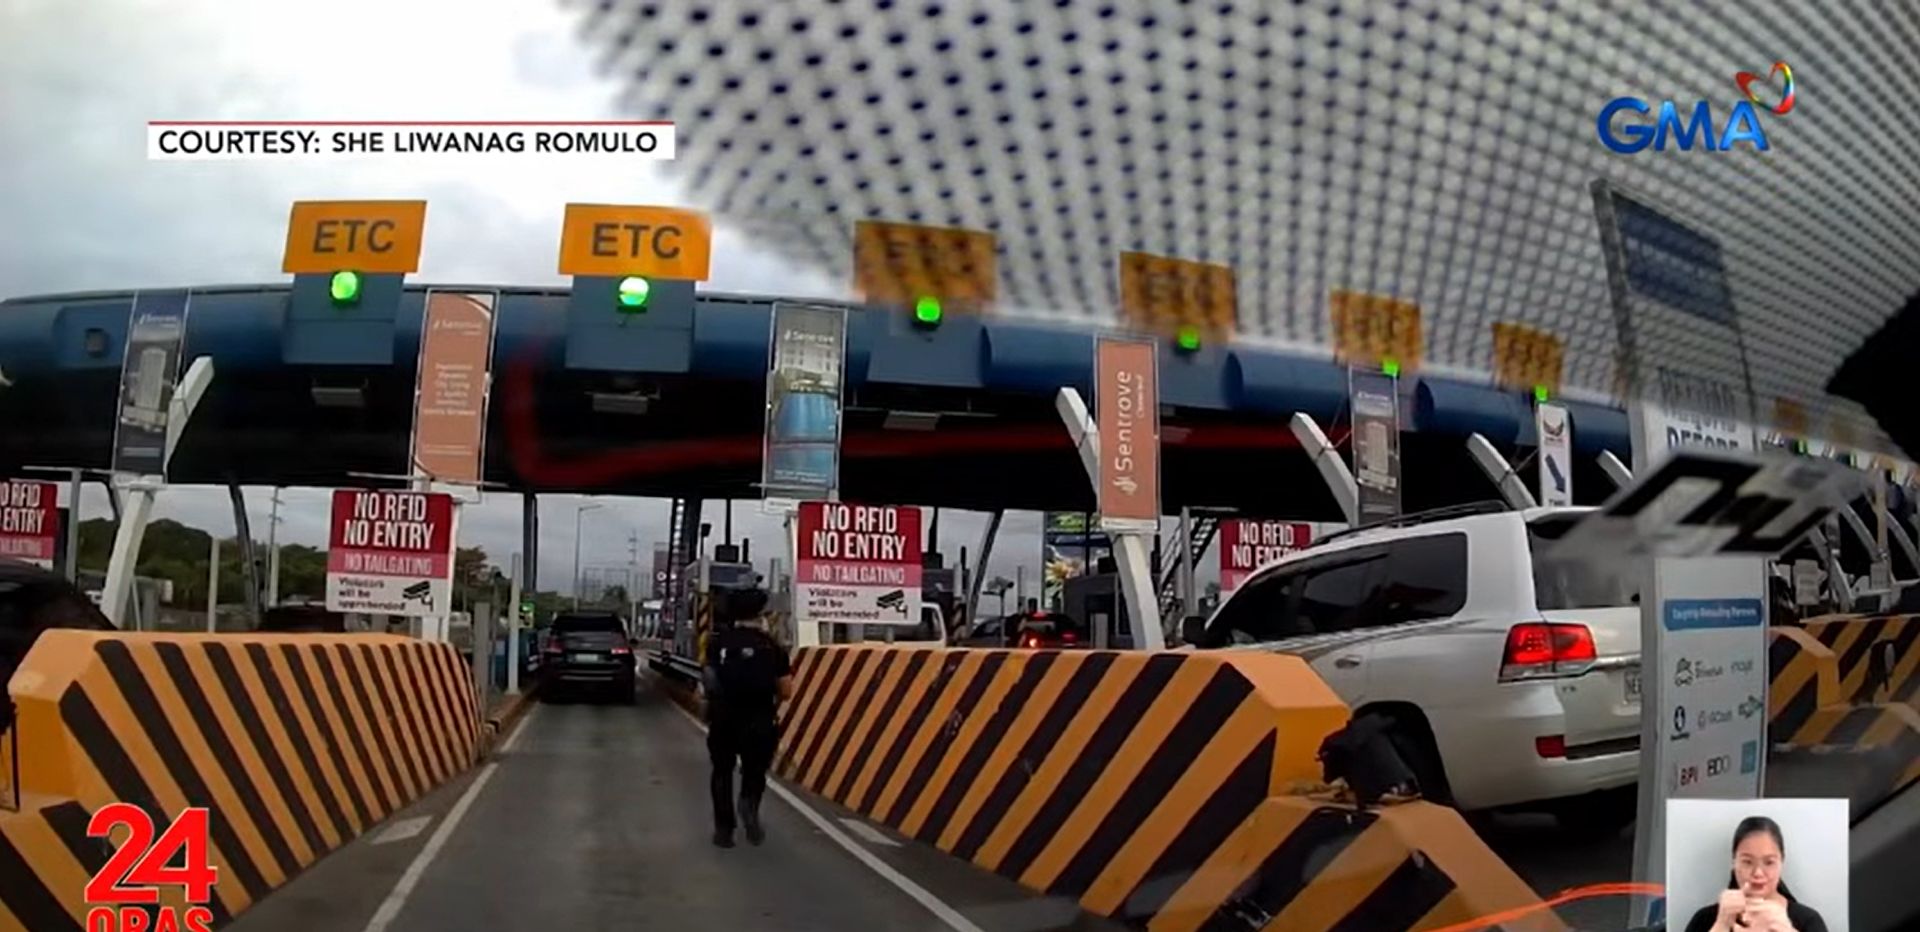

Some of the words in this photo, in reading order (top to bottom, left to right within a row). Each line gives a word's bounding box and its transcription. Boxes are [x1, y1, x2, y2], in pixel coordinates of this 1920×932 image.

[312, 219, 395, 254] ETC
[591, 221, 683, 260] ETC
[3, 507, 46, 534] ENTRY
[355, 492, 380, 520] NO
[384, 494, 427, 522] RFID
[822, 503, 850, 531] NO
[855, 506, 897, 533] RFID
[343, 519, 369, 546] NO
[373, 521, 435, 550] ENTRY
[812, 530, 839, 558] NO
[844, 532, 906, 561] ENTRY
[1239, 521, 1260, 545] NO
[1262, 523, 1294, 546] RFID
[363, 554, 433, 576] TAILGATING
[1232, 543, 1252, 568] NO
[813, 564, 831, 582] NO
[835, 565, 905, 585] TAILGATING
